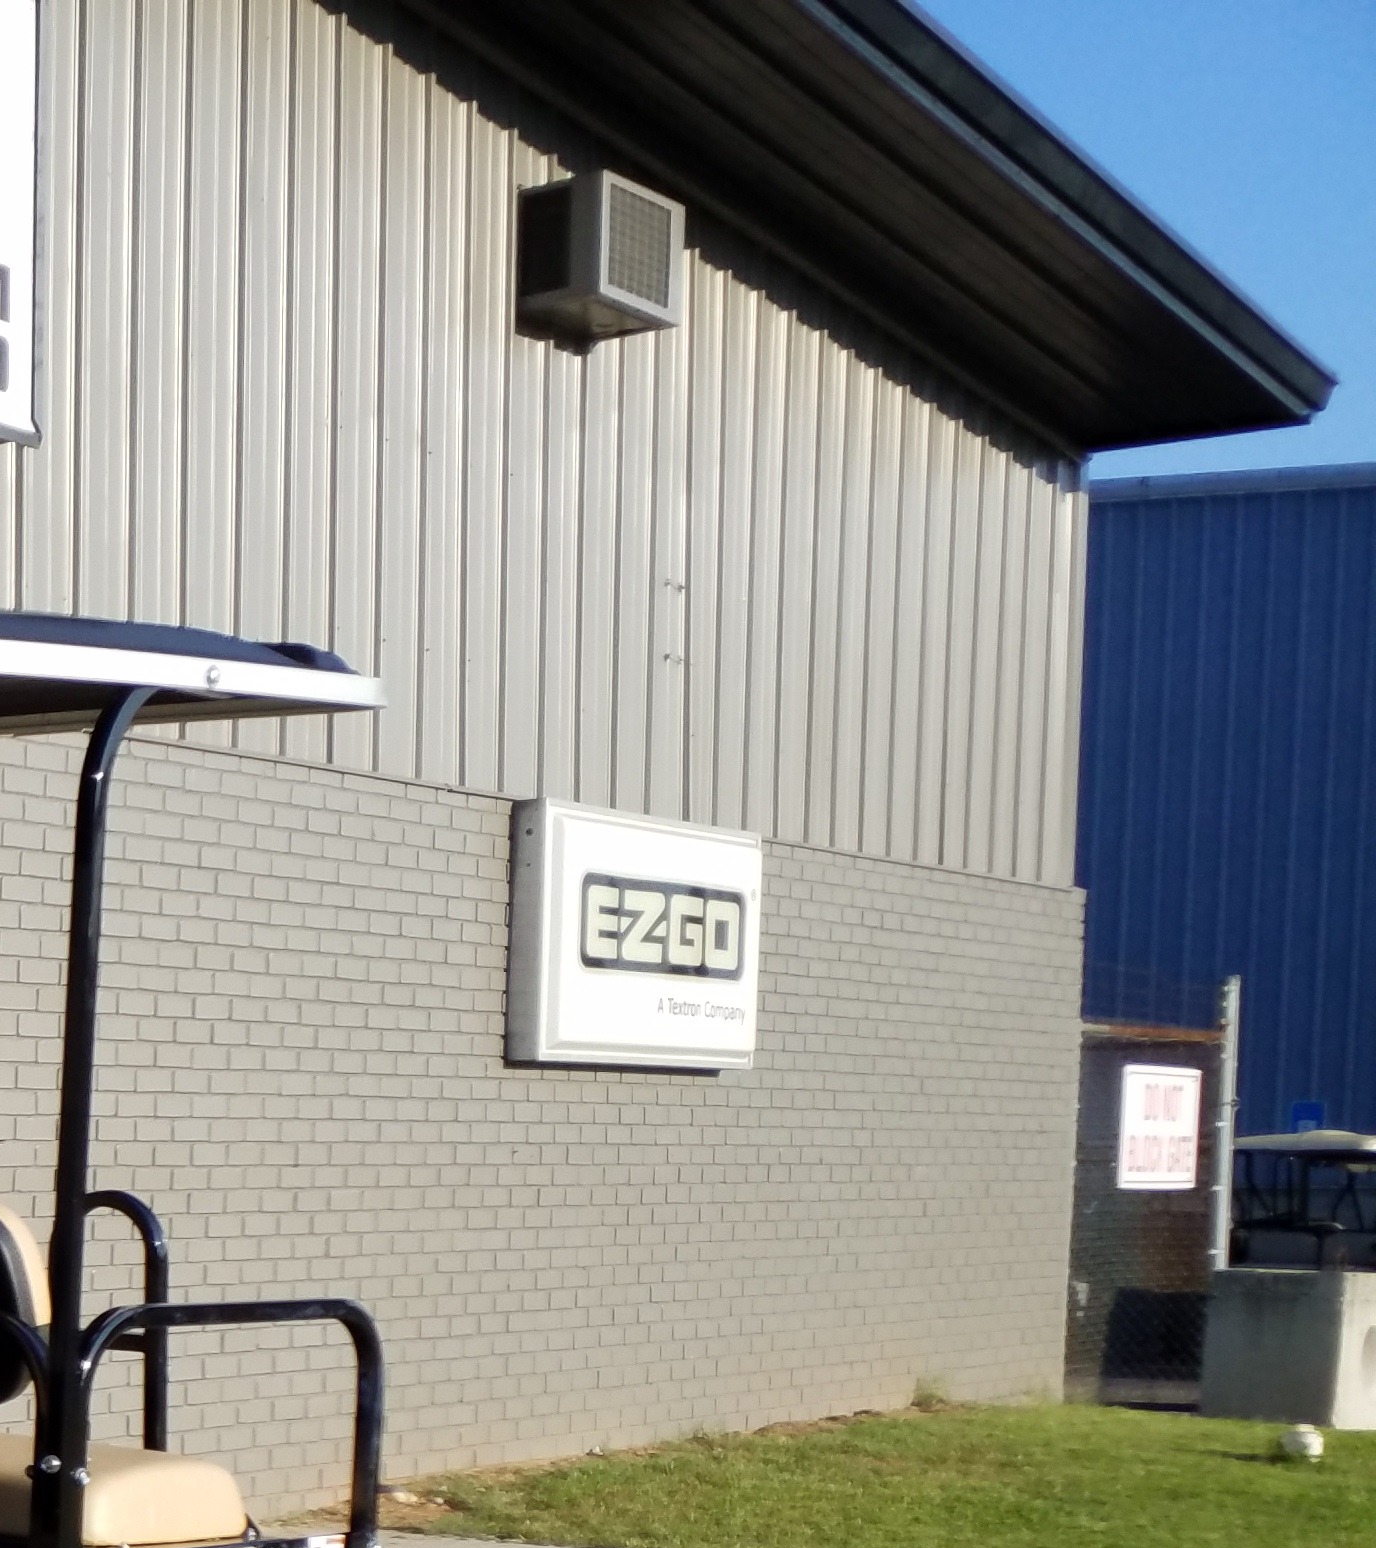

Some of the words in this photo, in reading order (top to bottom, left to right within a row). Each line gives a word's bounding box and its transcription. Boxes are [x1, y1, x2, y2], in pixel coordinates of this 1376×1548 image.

[585, 884, 741, 971] EZGO
[658, 997, 664, 1013] A
[668, 998, 702, 1016] Textron
[705, 1001, 746, 1026] Company
